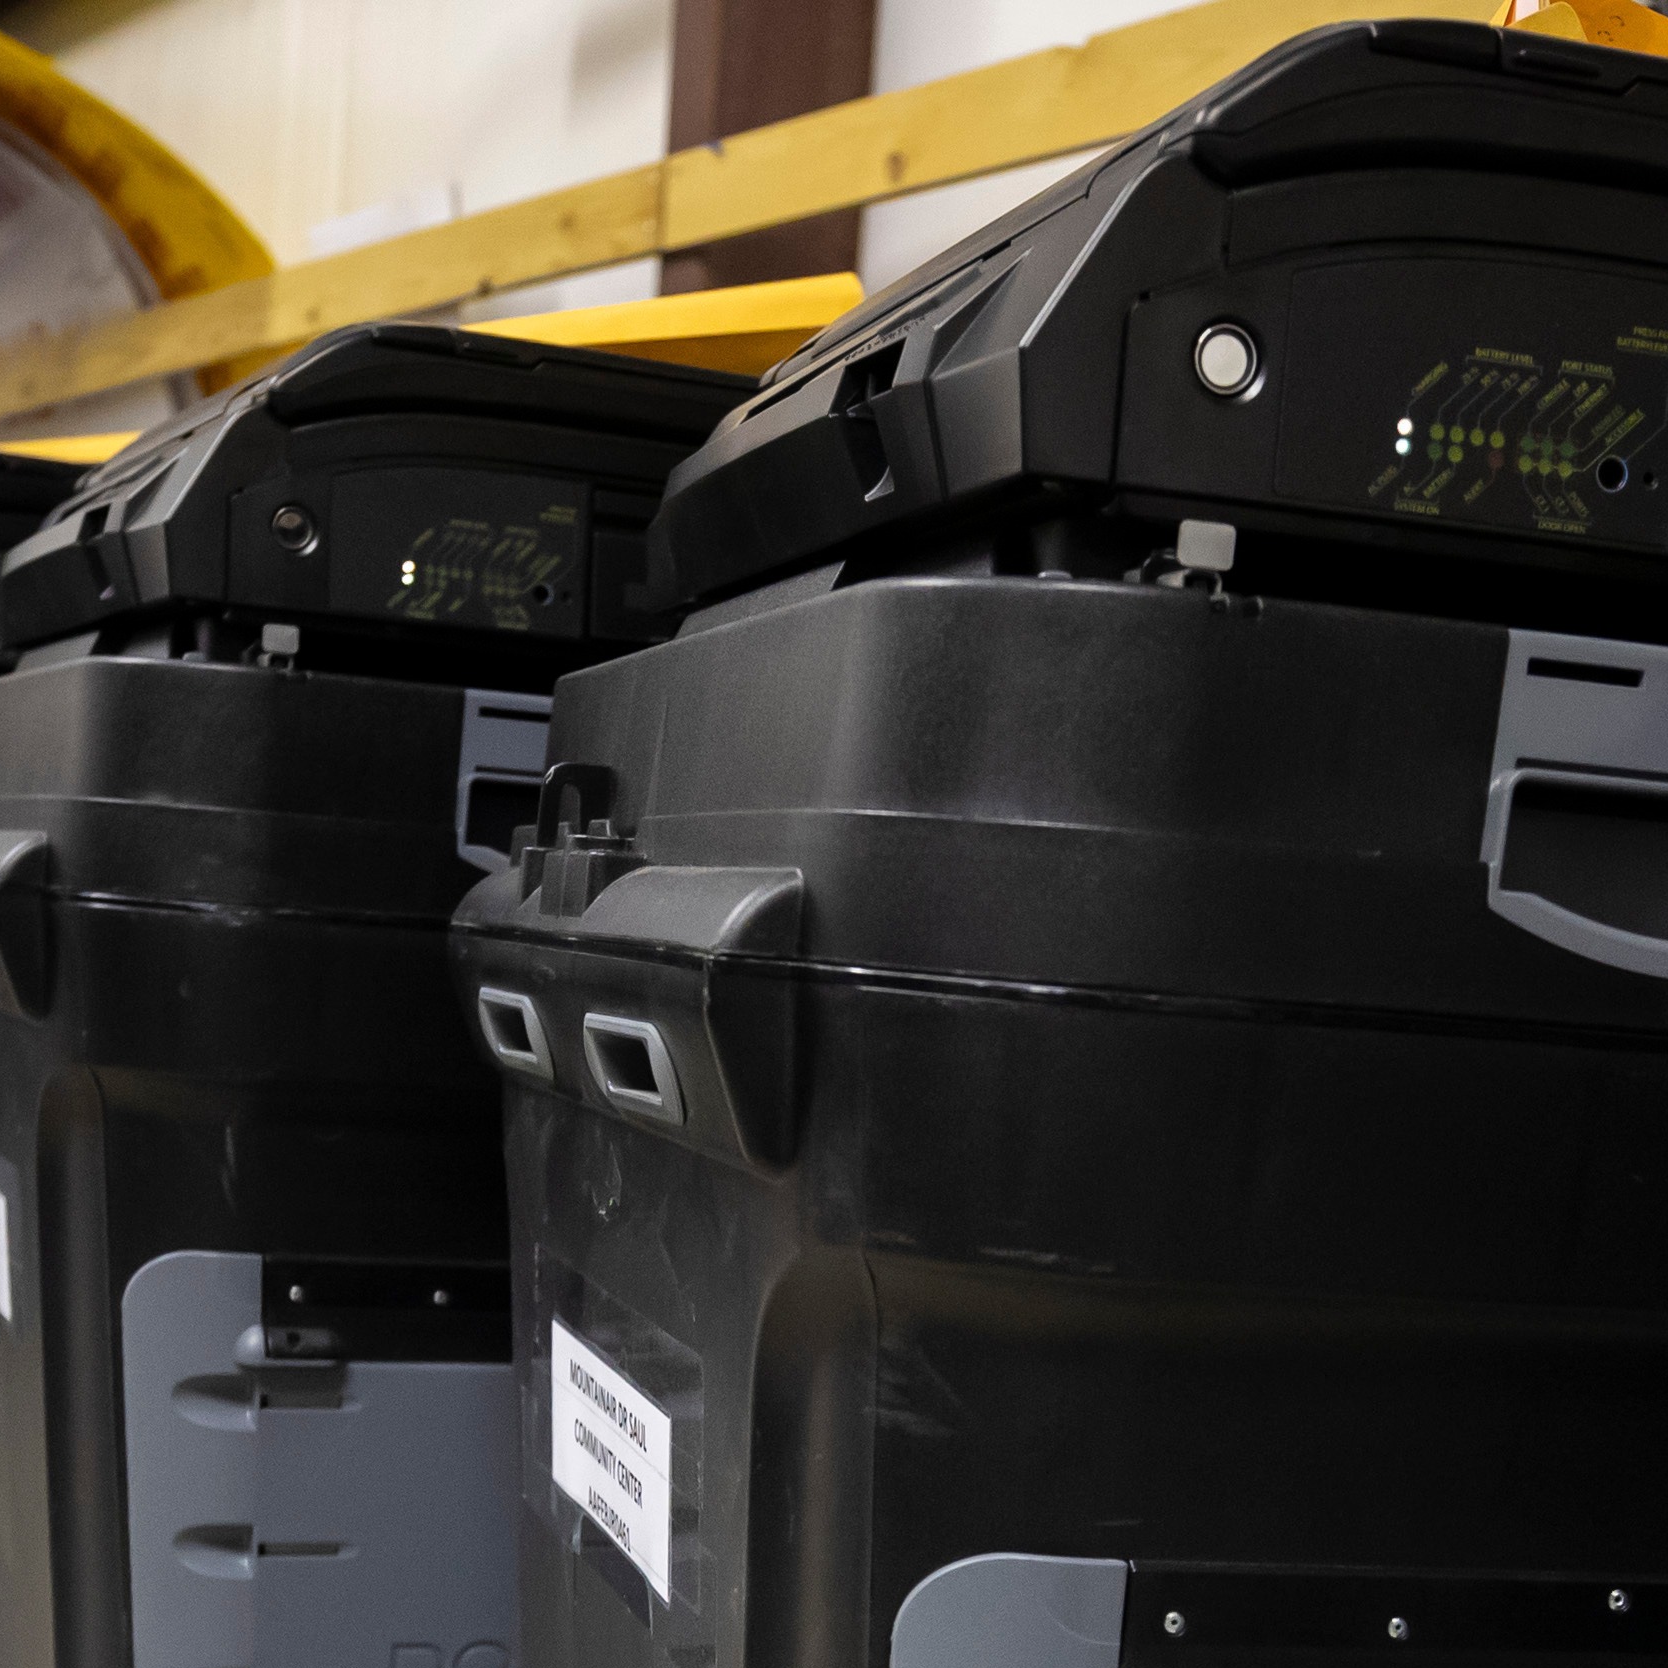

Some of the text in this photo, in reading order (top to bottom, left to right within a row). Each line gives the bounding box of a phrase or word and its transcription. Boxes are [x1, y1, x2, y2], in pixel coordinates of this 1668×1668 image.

[1616, 335, 1649, 351] BATTERY
[1474, 346, 1534, 366] BATTERY LEVEL
[1561, 359, 1614, 377] PORT STATUS
[1537, 518, 1588, 535] DOOR OPEN
[569, 1358, 648, 1454] MOUNTAINAIR DR SAUL
[574, 1418, 644, 1510] COMMUNITY CENTER
